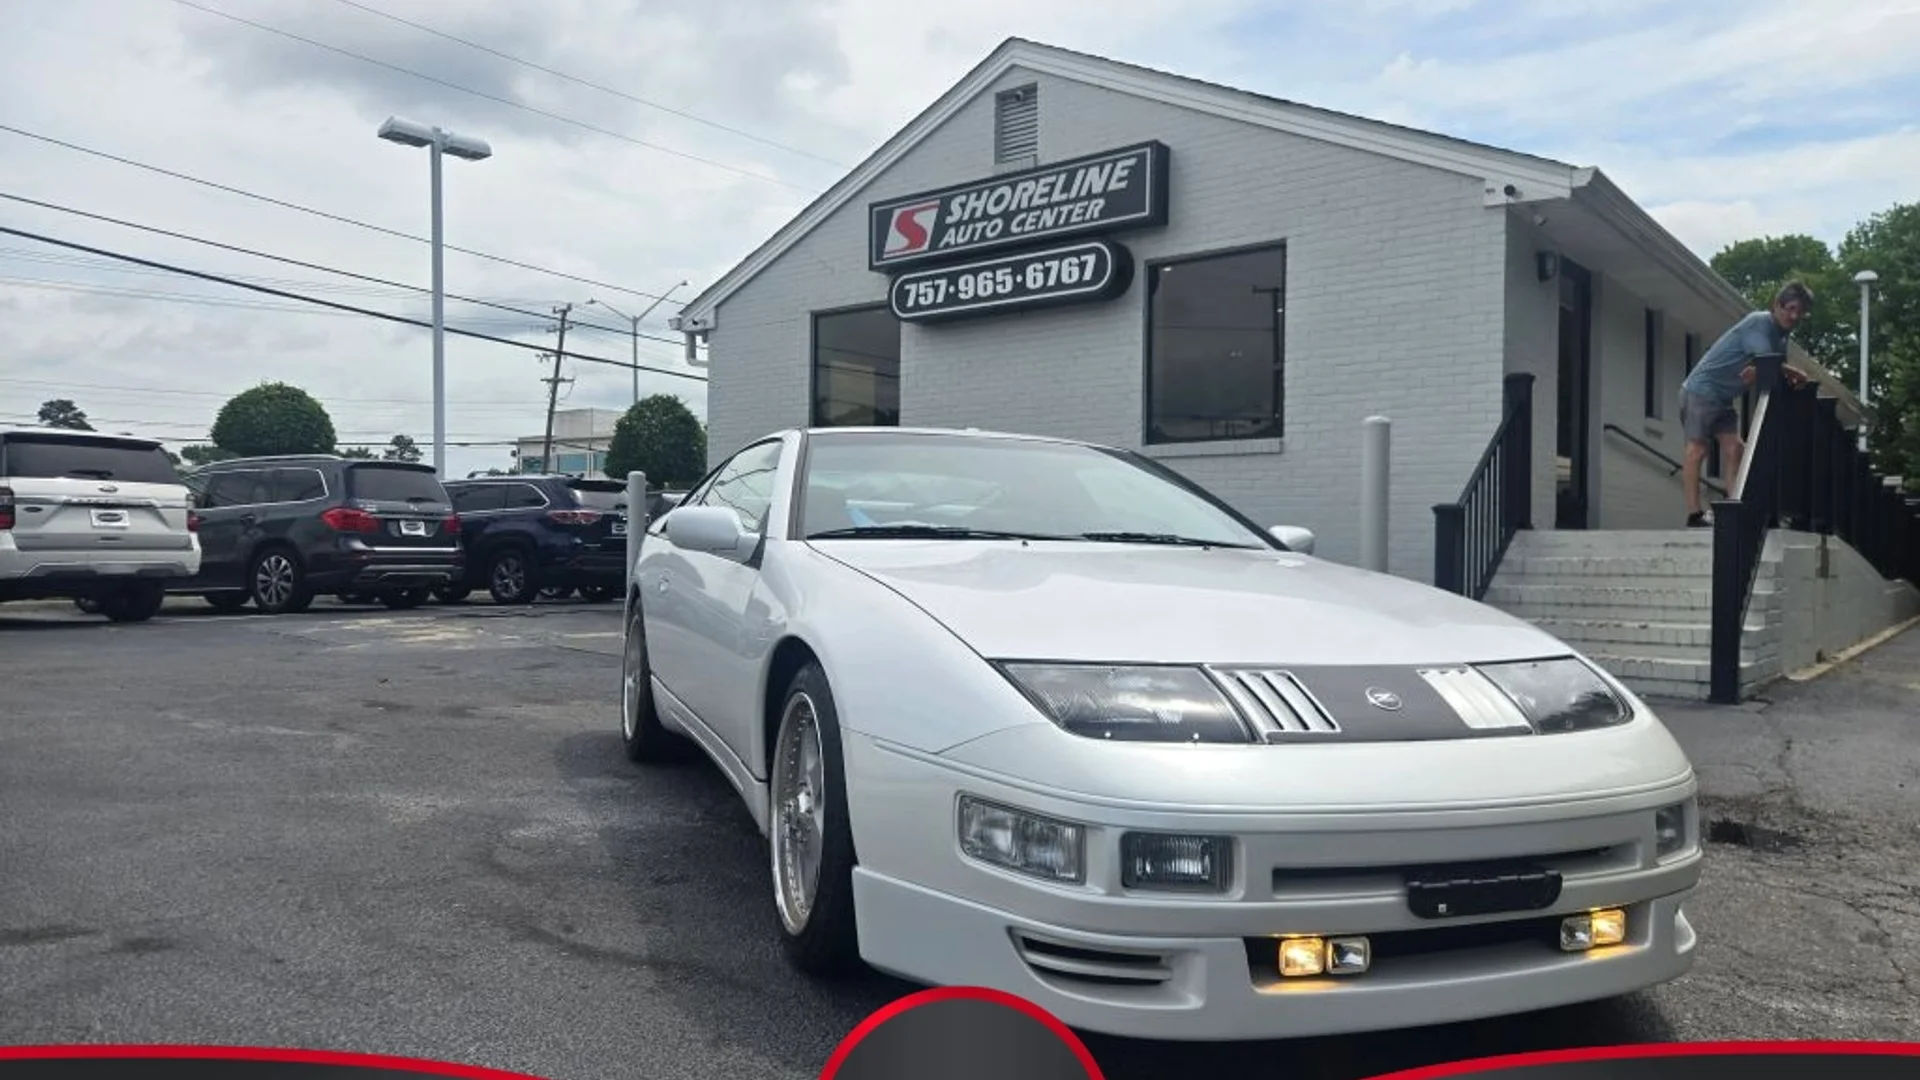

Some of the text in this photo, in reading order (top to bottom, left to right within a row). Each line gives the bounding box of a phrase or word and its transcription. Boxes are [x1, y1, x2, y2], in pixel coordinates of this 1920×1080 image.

[944, 158, 1137, 224] SHORELINE
[939, 199, 1105, 248] AUTO CENTER
